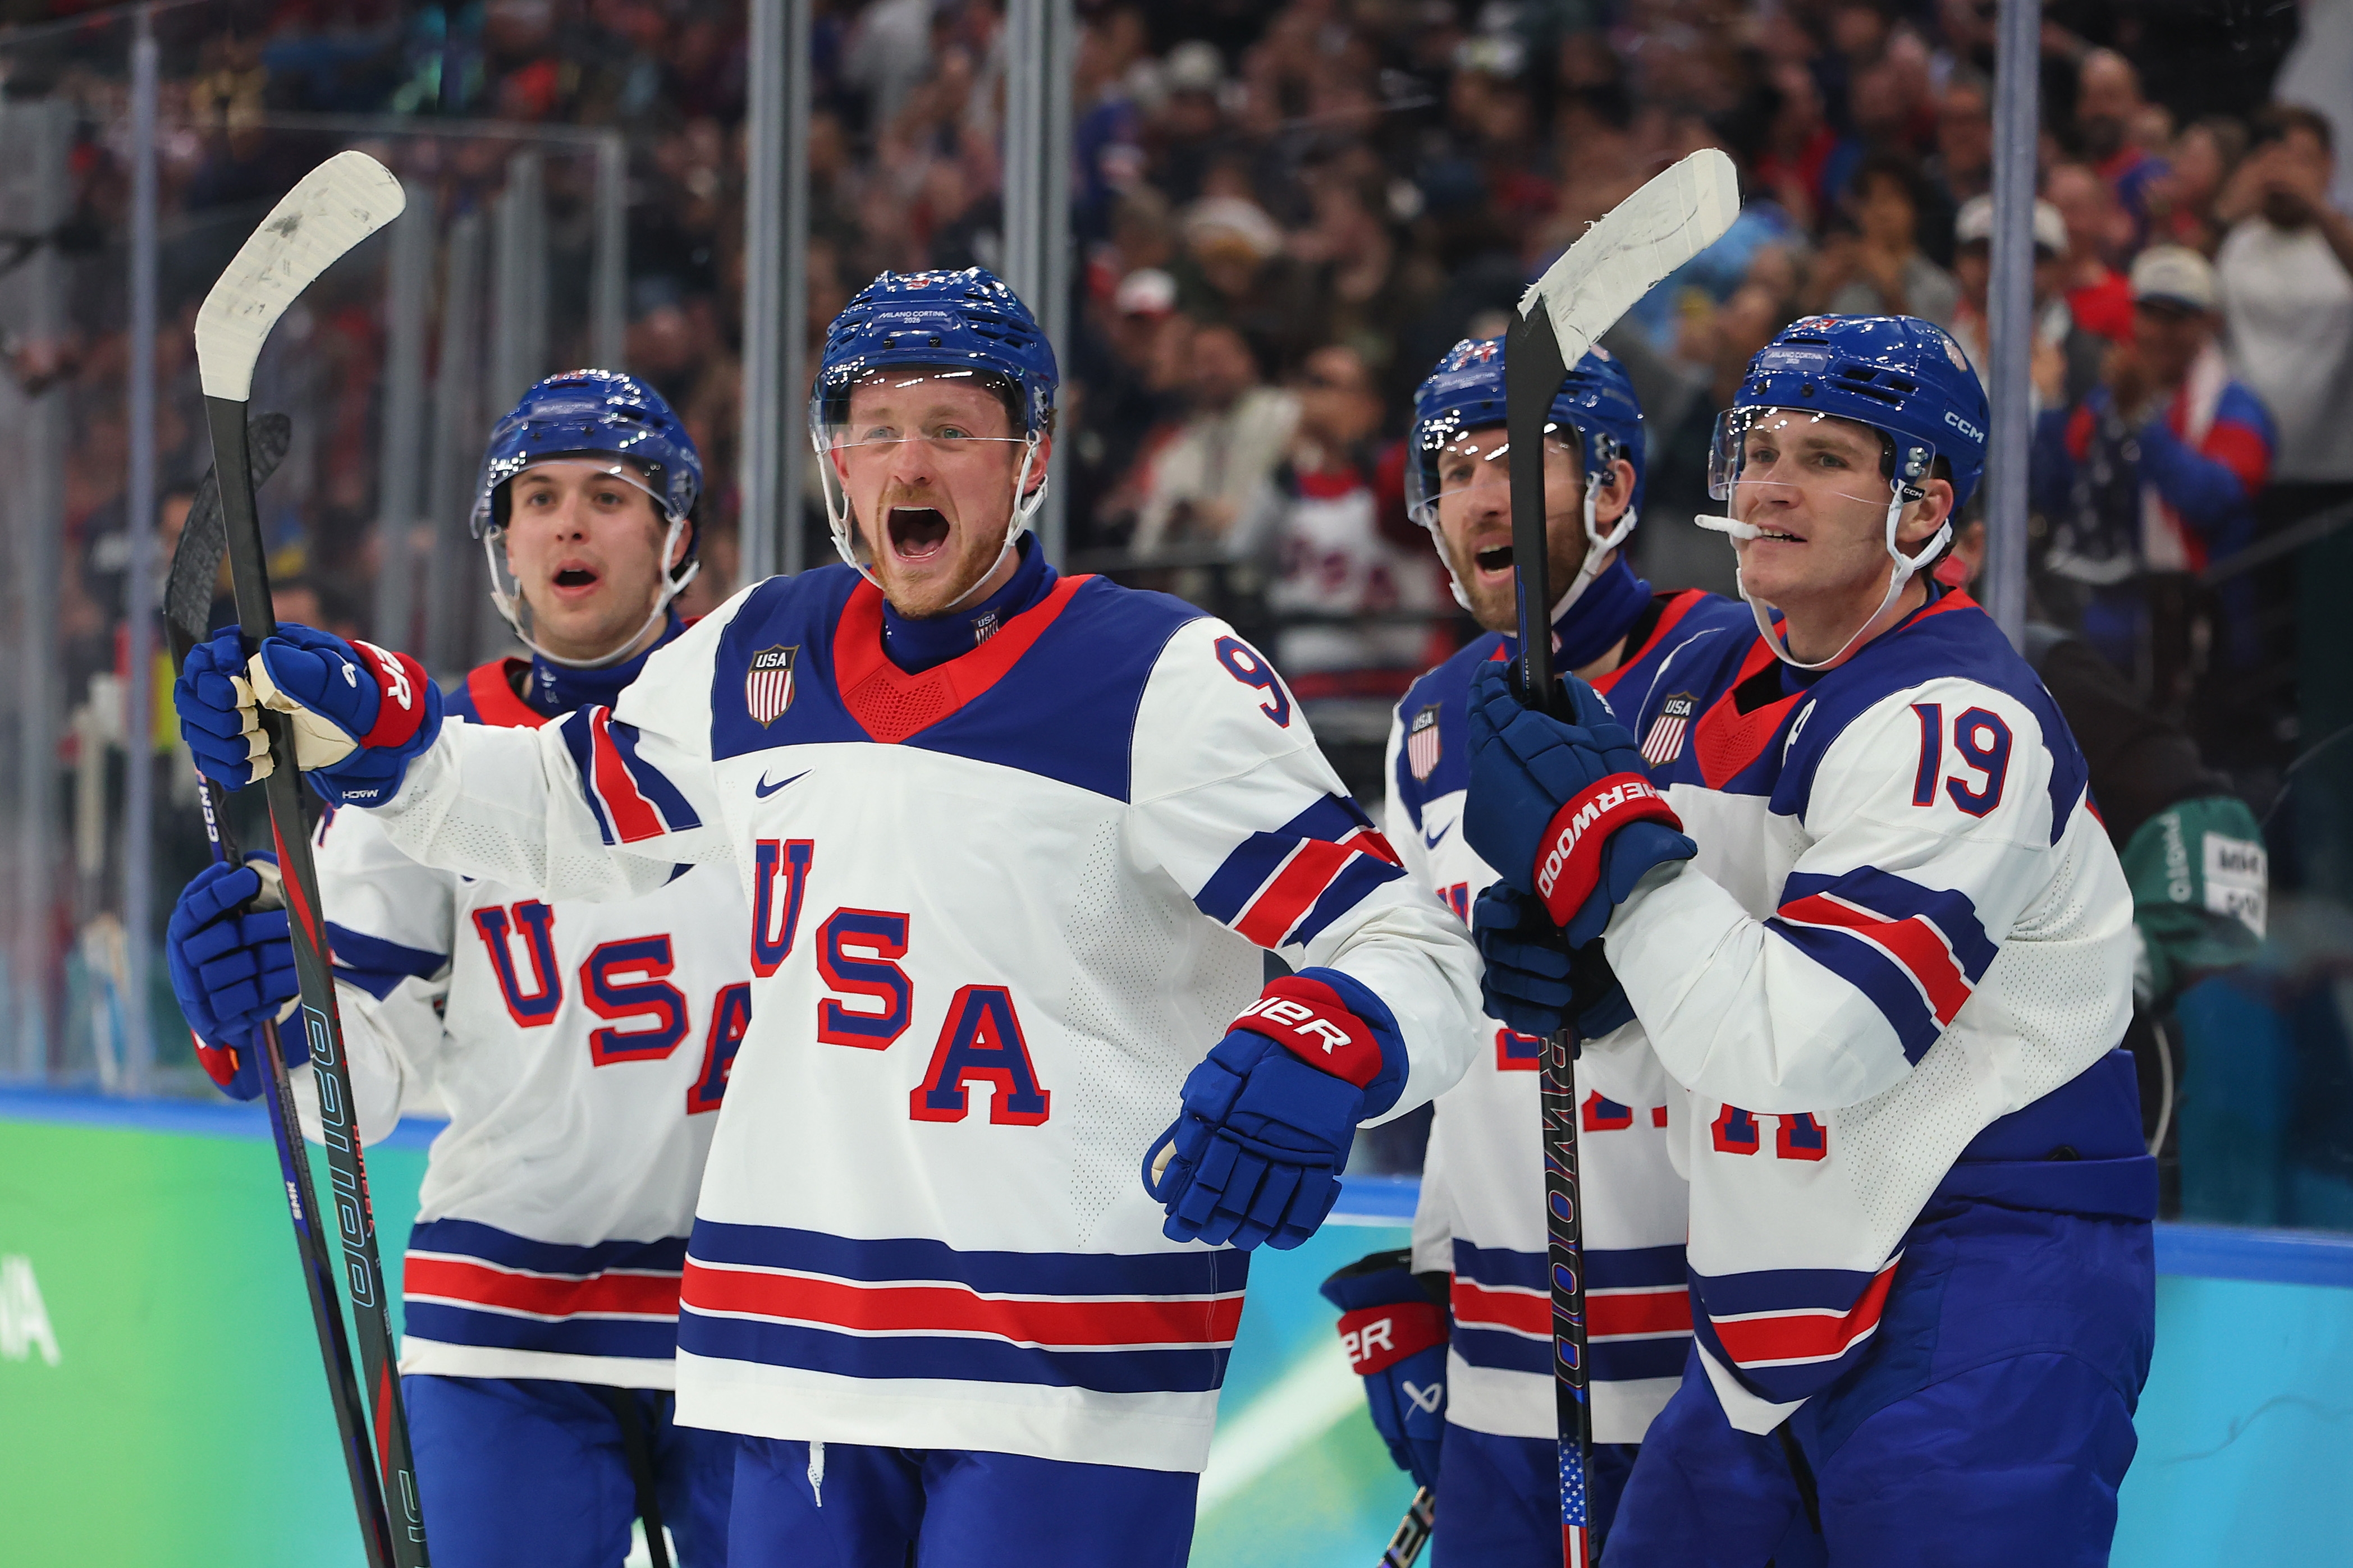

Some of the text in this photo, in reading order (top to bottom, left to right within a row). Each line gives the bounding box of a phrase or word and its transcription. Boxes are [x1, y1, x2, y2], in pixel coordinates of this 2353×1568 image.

[1944, 411, 1984, 444] CCM
[1903, 488, 1922, 498] CCM
[977, 613, 996, 627] USA
[756, 652, 786, 668] USA
[1214, 635, 1290, 729] 9
[1665, 699, 1692, 716] USA
[1412, 710, 1434, 732] USA
[1910, 703, 2013, 819] 19
[342, 789, 379, 800] MACH
[198, 786, 219, 842] CCM
[750, 839, 1050, 1127] USA
